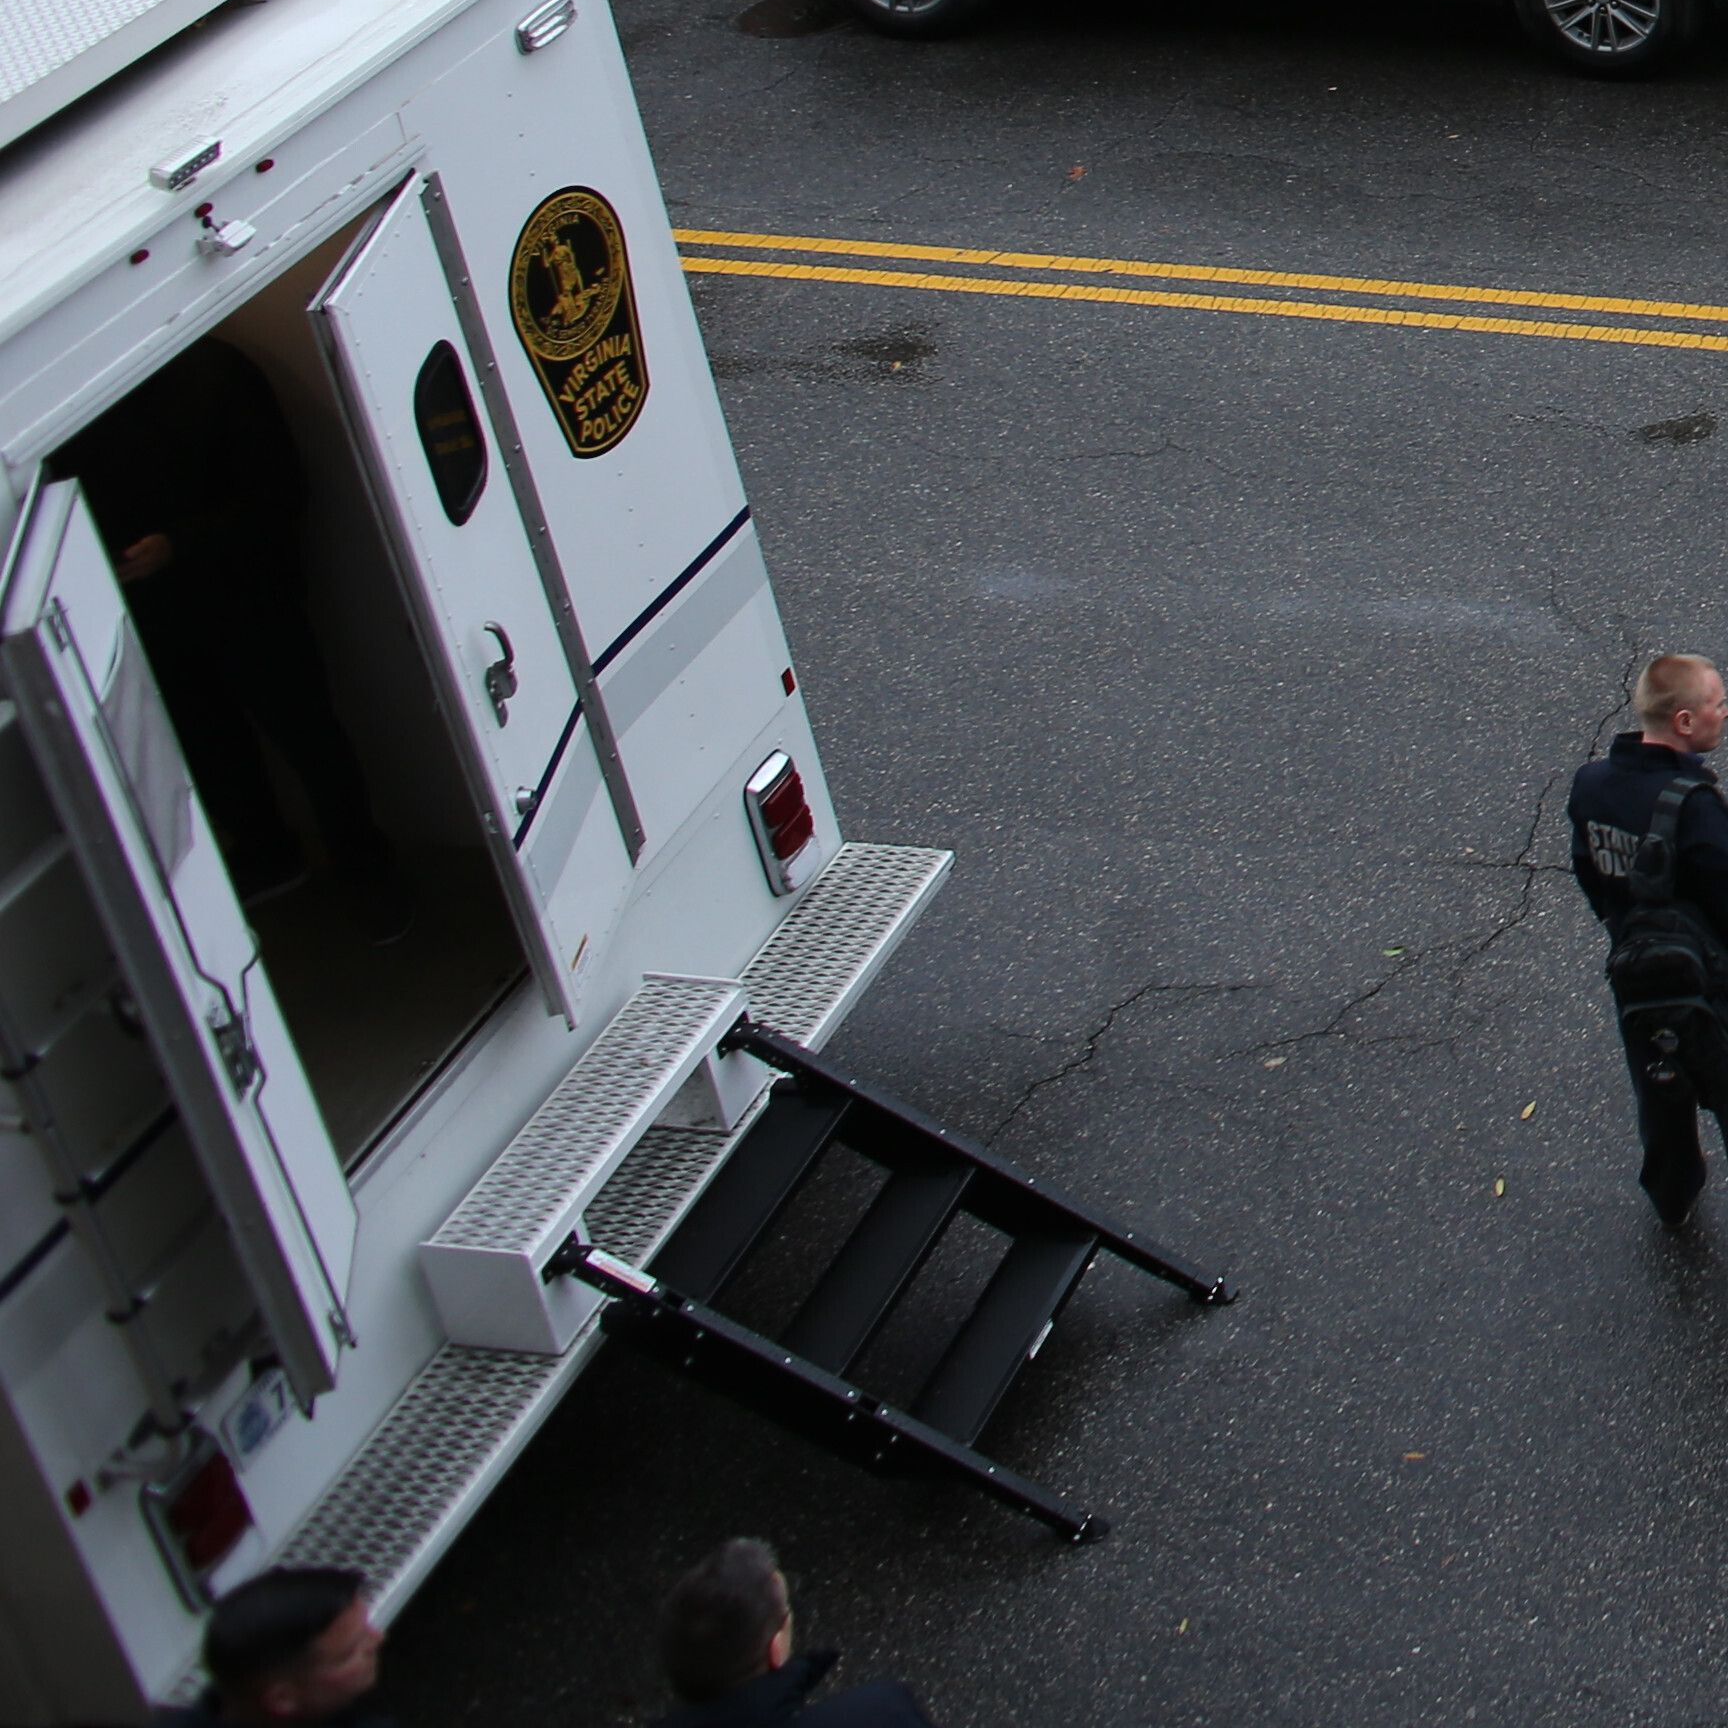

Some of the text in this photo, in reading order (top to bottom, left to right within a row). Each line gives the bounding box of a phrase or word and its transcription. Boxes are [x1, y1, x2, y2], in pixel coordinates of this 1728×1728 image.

[558, 333, 632, 404] VIRGINIA
[575, 360, 630, 420] STATE
[580, 380, 640, 443] POLICE
